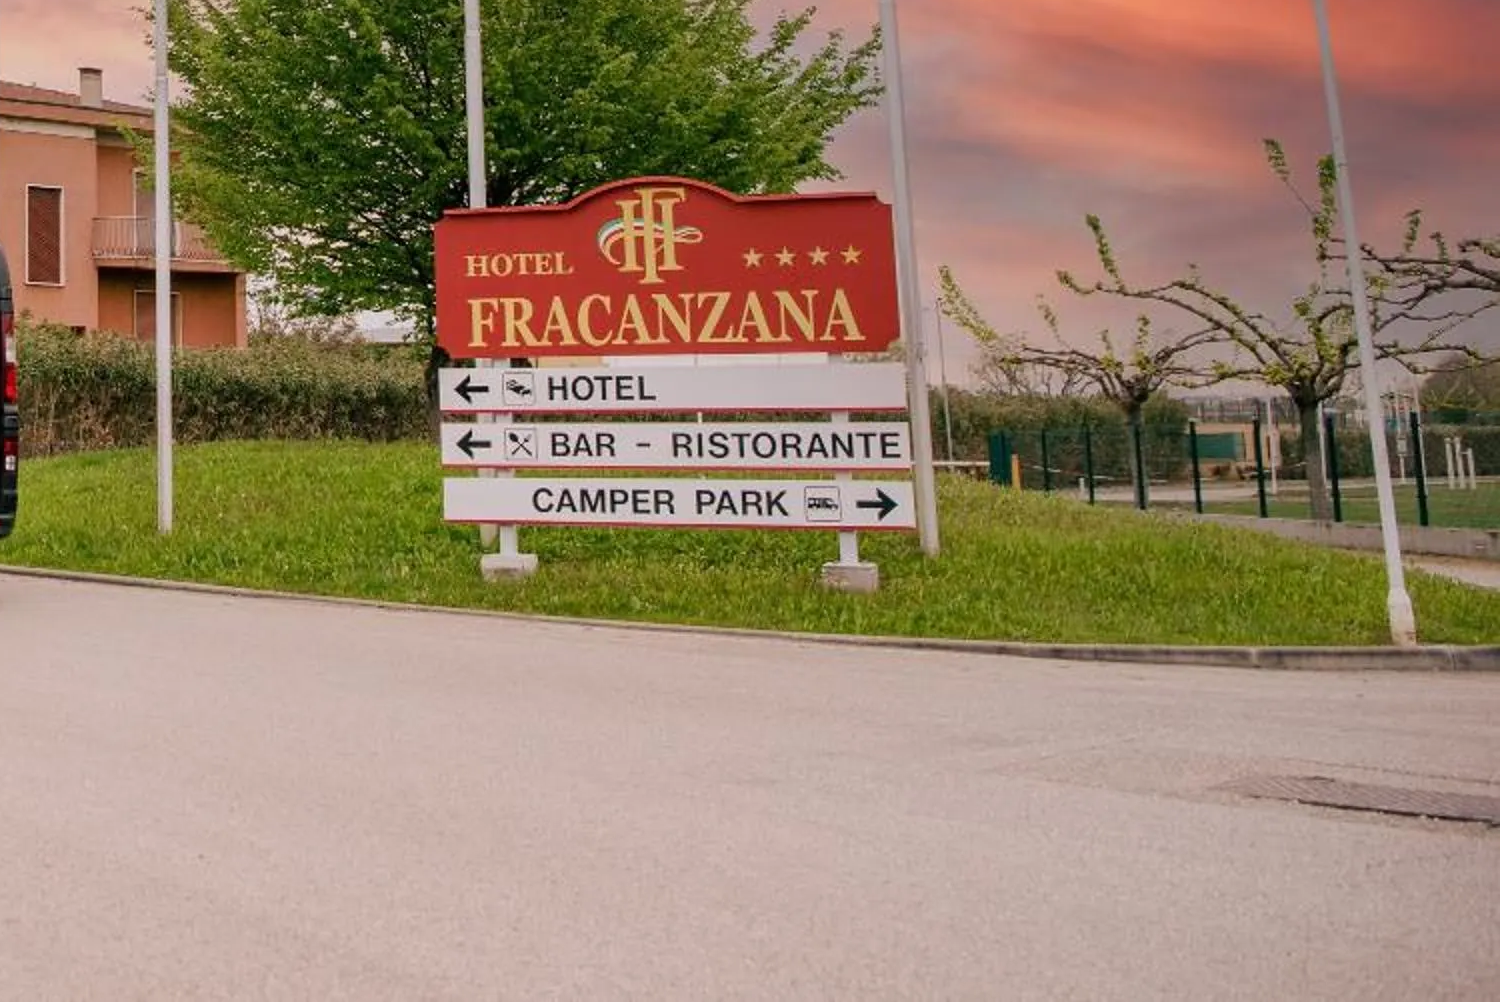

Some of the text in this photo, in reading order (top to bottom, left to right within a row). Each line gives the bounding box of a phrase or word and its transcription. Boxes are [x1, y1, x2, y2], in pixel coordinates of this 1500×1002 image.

[464, 251, 573, 277] HOTEL
[467, 288, 866, 348] FRACANZANA
[547, 375, 657, 401] HOTEL
[550, 432, 616, 457] BAR
[671, 432, 901, 459] RISTORANTE
[532, 487, 789, 517] CAMPER PARK
